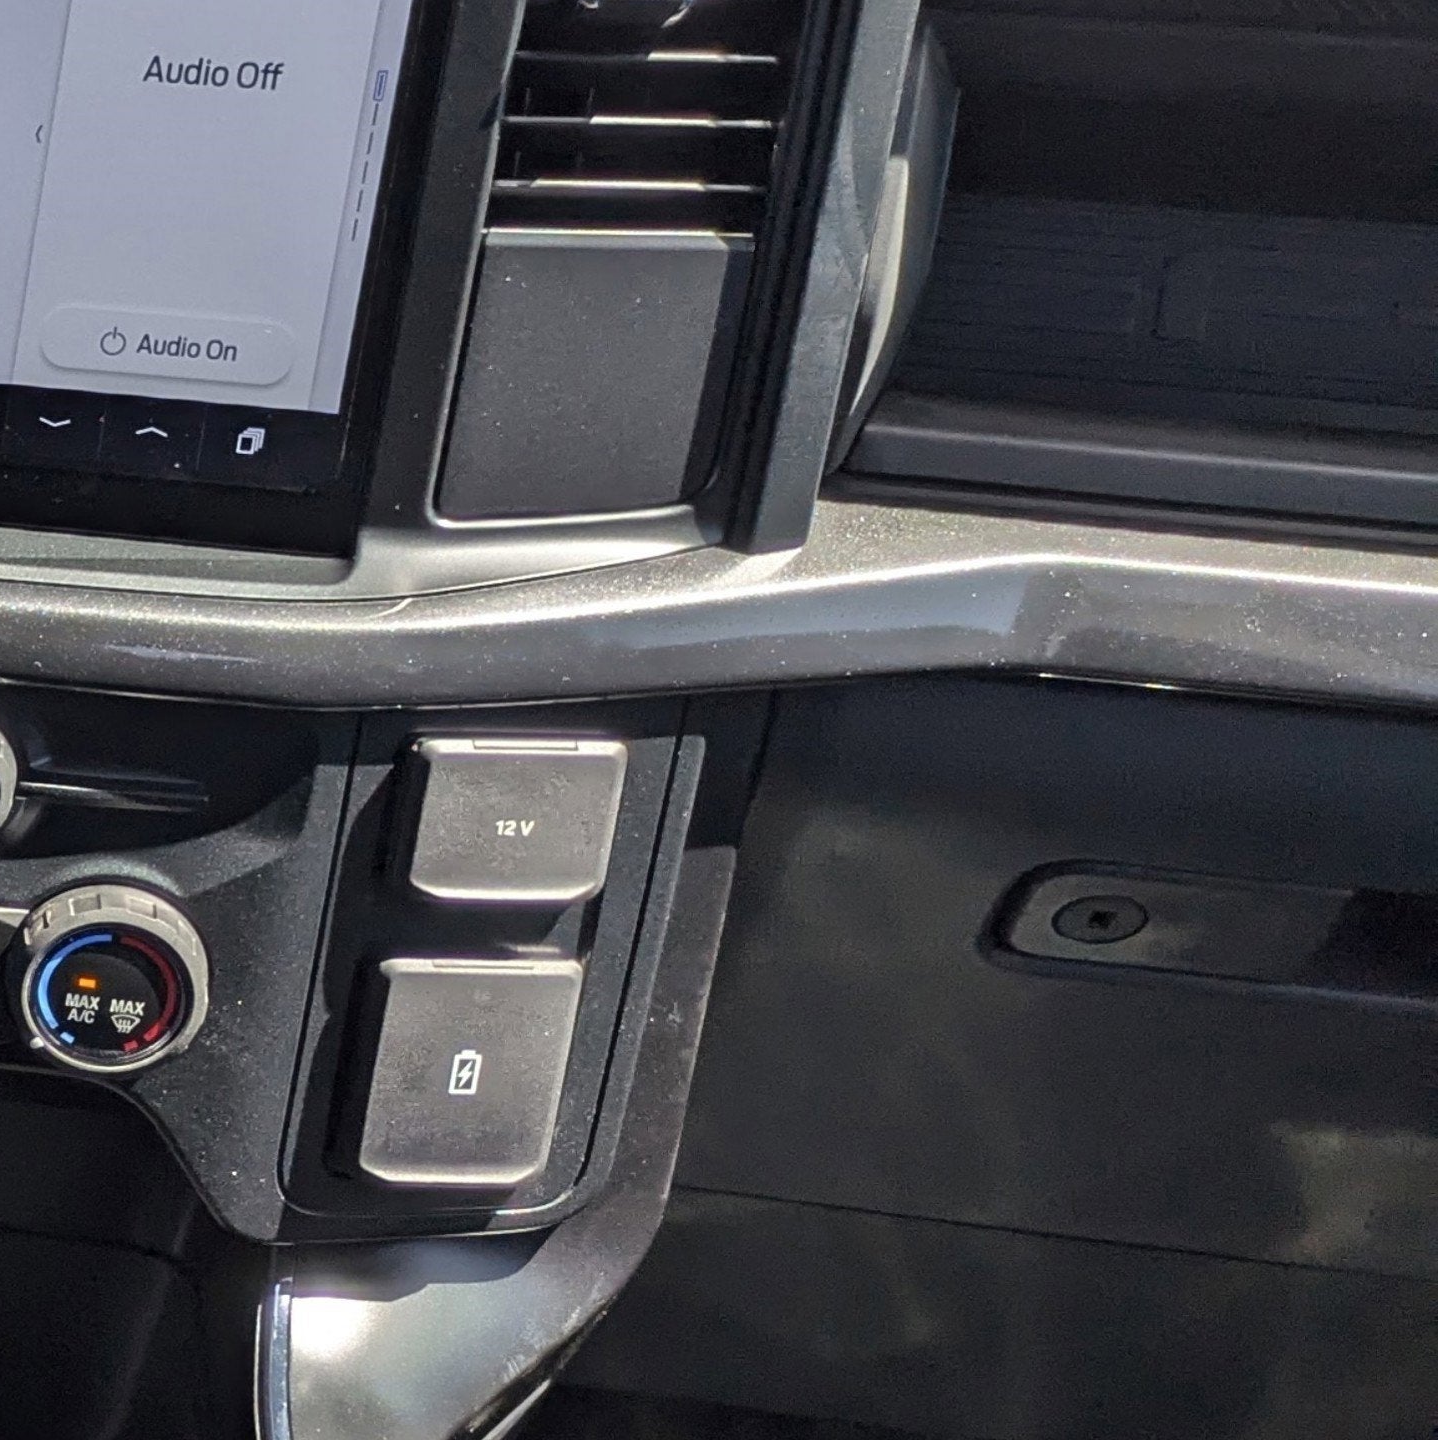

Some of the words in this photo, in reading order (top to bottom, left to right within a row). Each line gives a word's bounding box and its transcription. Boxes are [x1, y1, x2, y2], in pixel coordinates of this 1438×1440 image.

[142, 54, 230, 90] Audio
[236, 60, 286, 93] Off
[136, 333, 201, 361] Audio
[206, 338, 239, 363] On
[65, 992, 101, 1011] MAX
[109, 997, 146, 1016] MAX
[67, 1008, 97, 1025] A/C
